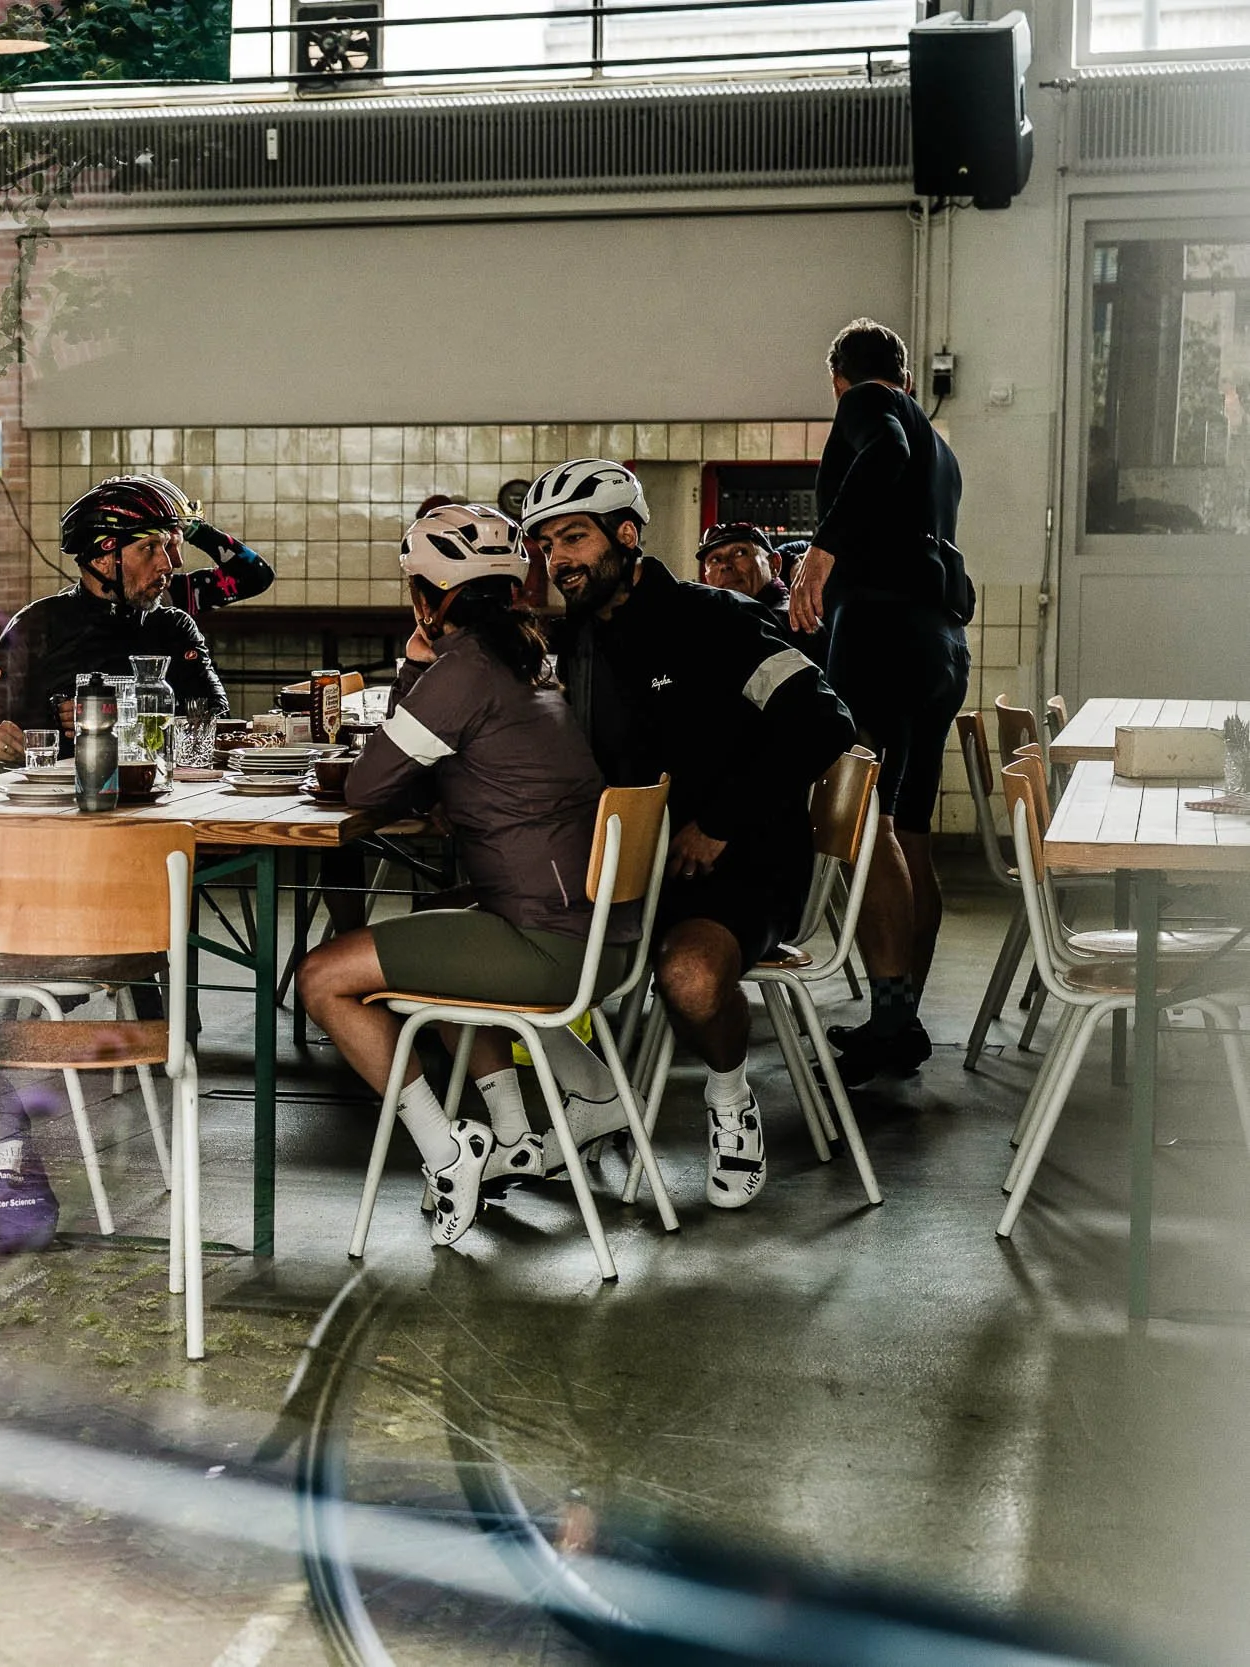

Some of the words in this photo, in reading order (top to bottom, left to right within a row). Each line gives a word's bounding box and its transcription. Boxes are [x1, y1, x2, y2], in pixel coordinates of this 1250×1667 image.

[742, 1171, 760, 1195] LAKE
[9, 1198, 36, 1207] Science
[442, 1219, 458, 1241] LAKE
